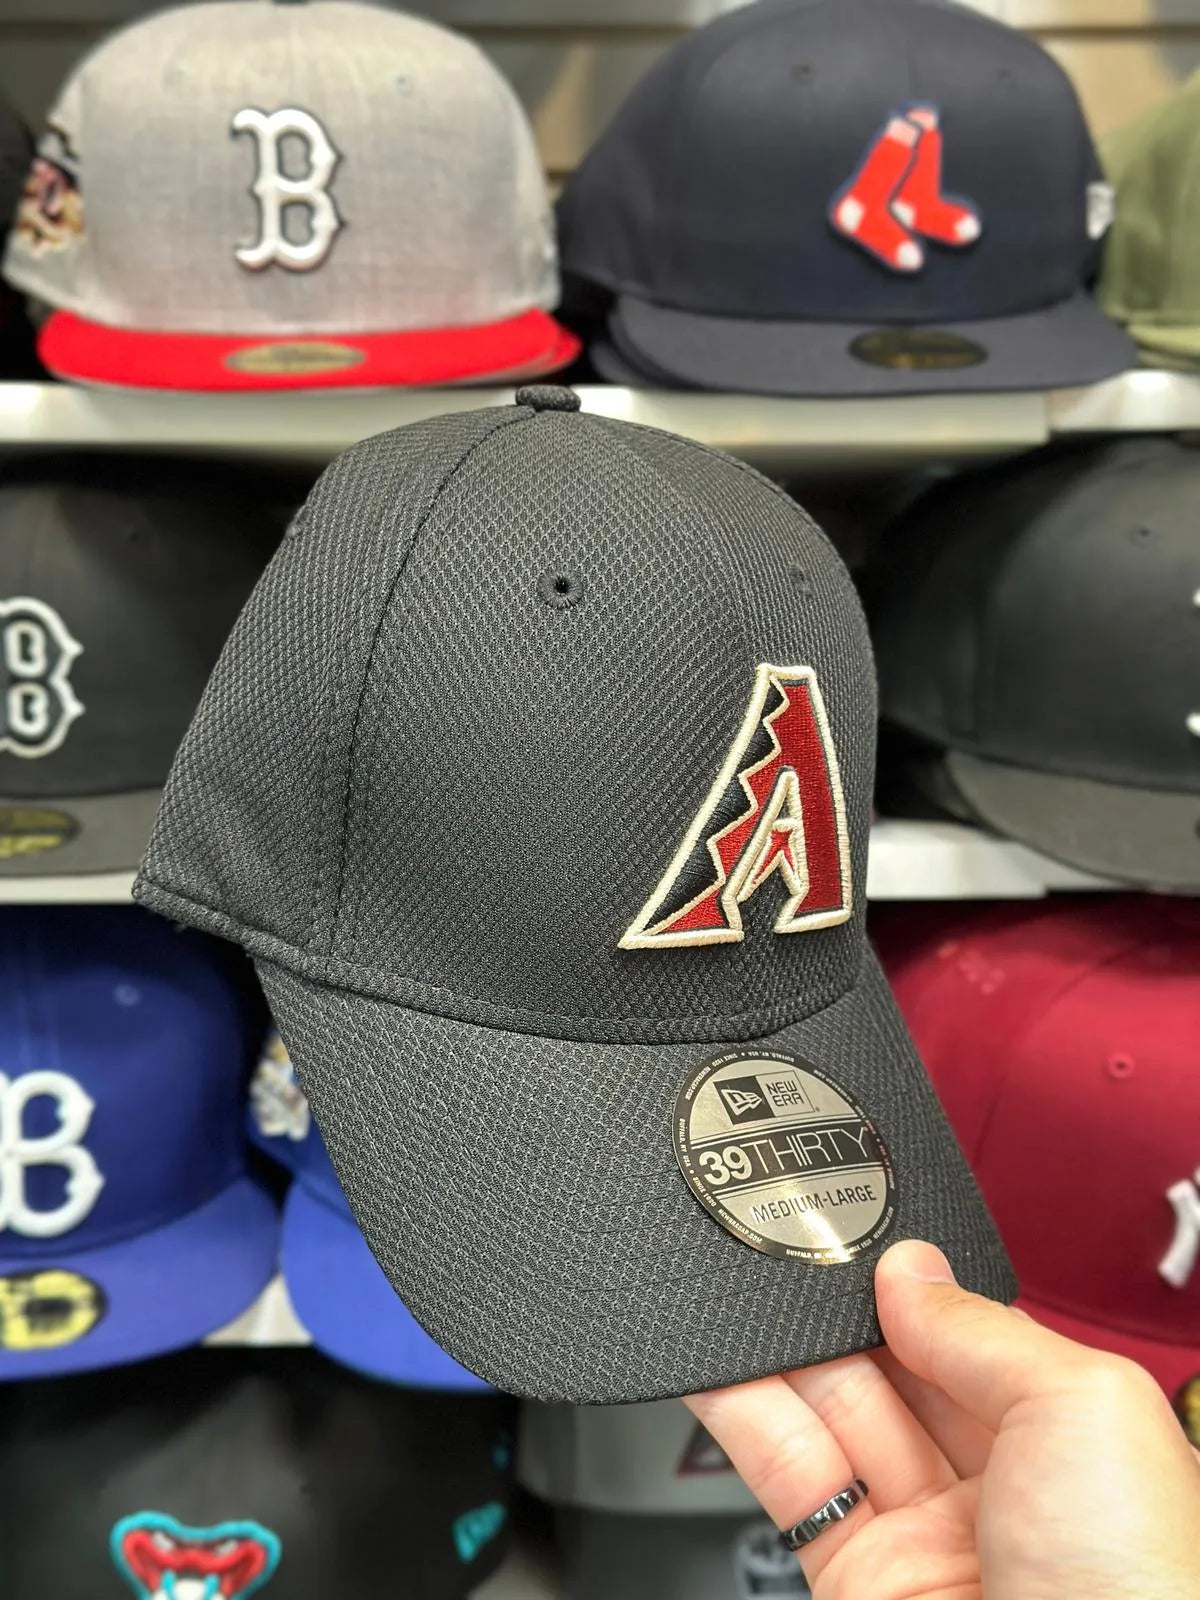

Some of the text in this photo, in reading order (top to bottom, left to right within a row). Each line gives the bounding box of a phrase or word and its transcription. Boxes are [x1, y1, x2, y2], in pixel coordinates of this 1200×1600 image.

[231, 108, 346, 271] B
[617, 662, 852, 949] A
[765, 1079, 798, 1096] NEW
[772, 1091, 805, 1108] ERA
[699, 1126, 868, 1186] 39THIRTY
[752, 1184, 877, 1225] MEDIUM-LARGE
